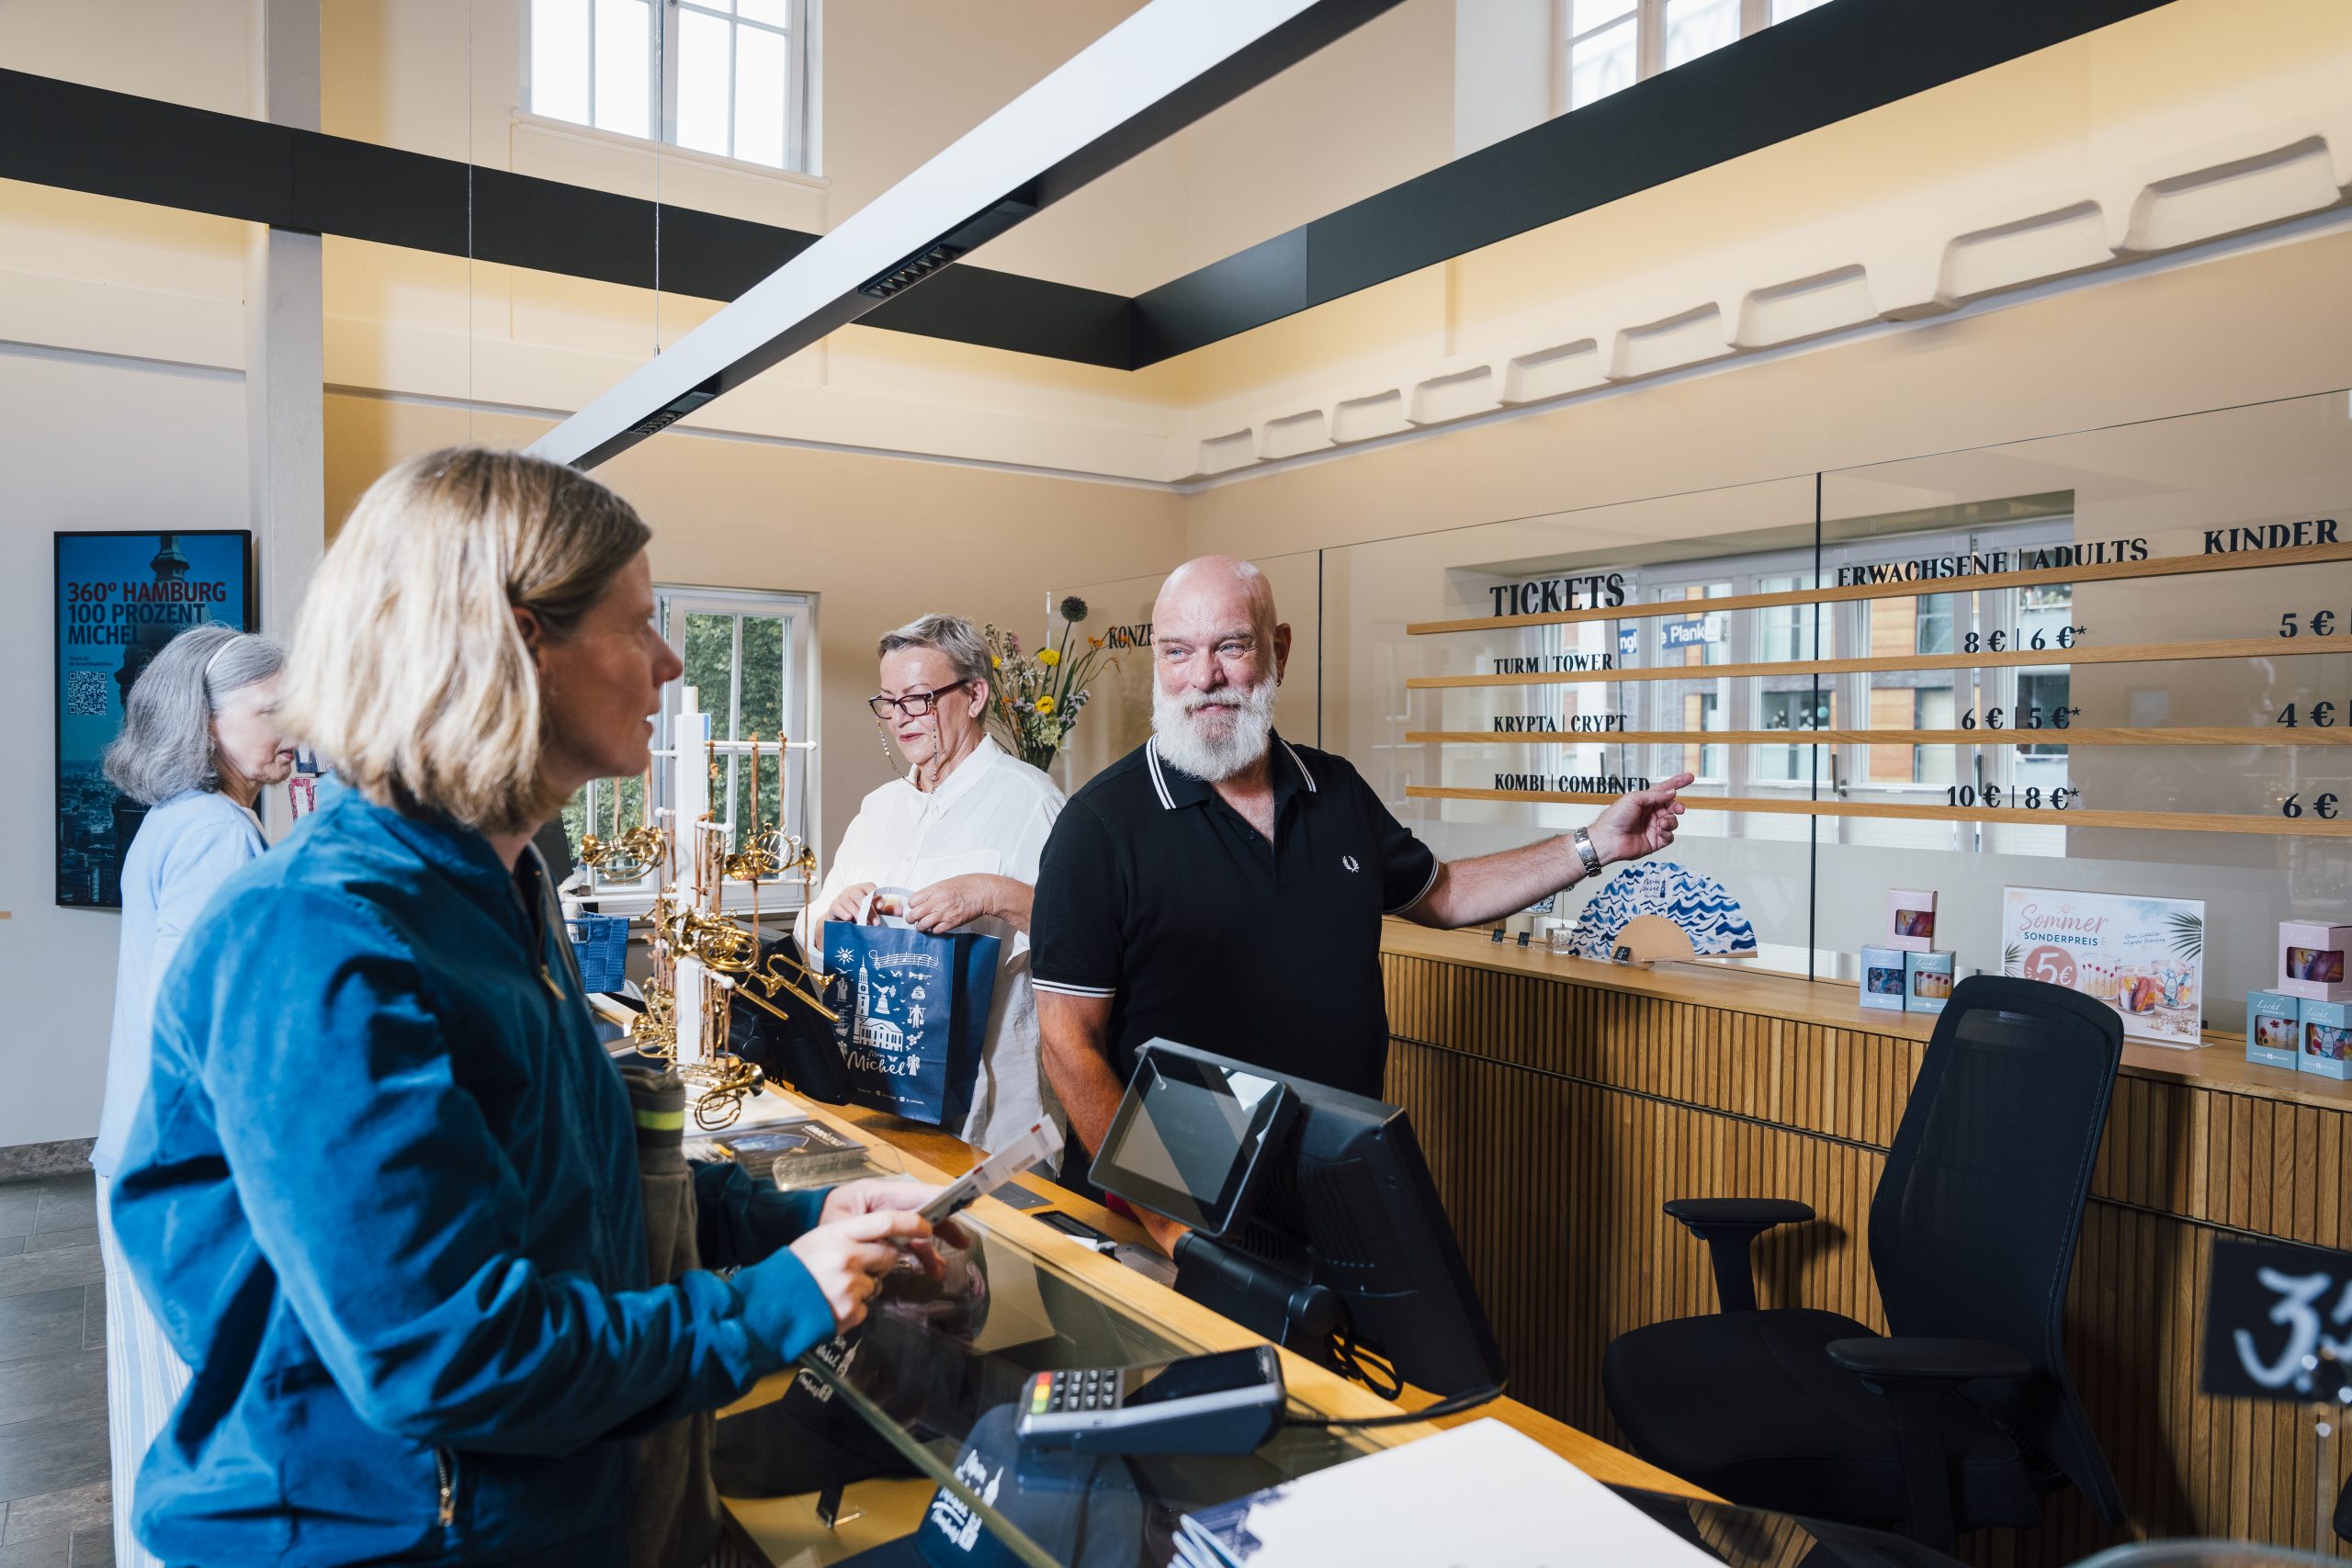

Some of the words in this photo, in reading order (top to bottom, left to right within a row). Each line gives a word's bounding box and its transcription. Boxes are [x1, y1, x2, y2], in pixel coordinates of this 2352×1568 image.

[2203, 519, 2339, 555] KINDER
[1838, 552, 2007, 588] ERWACHSENE
[2033, 537, 2148, 570] ADULTS
[123, 581, 227, 603] HAMBURG
[1489, 573, 1625, 617] TICKETS
[68, 604, 106, 624] 100
[112, 604, 206, 624] PROZENT
[68, 625, 142, 645] MICHEL
[1493, 657, 1540, 675] TURM
[1553, 653, 1612, 672] TOWER
[1493, 716, 1557, 732] KRYPTA
[1570, 715, 1627, 732] CRYPT
[1494, 773, 1545, 792] KOMBI
[1558, 775, 1650, 795] COMBINED
[2018, 903, 2109, 934] Sommer
[2024, 931, 2098, 946] SONDERPREIS
[847, 1051, 906, 1076] Michel
